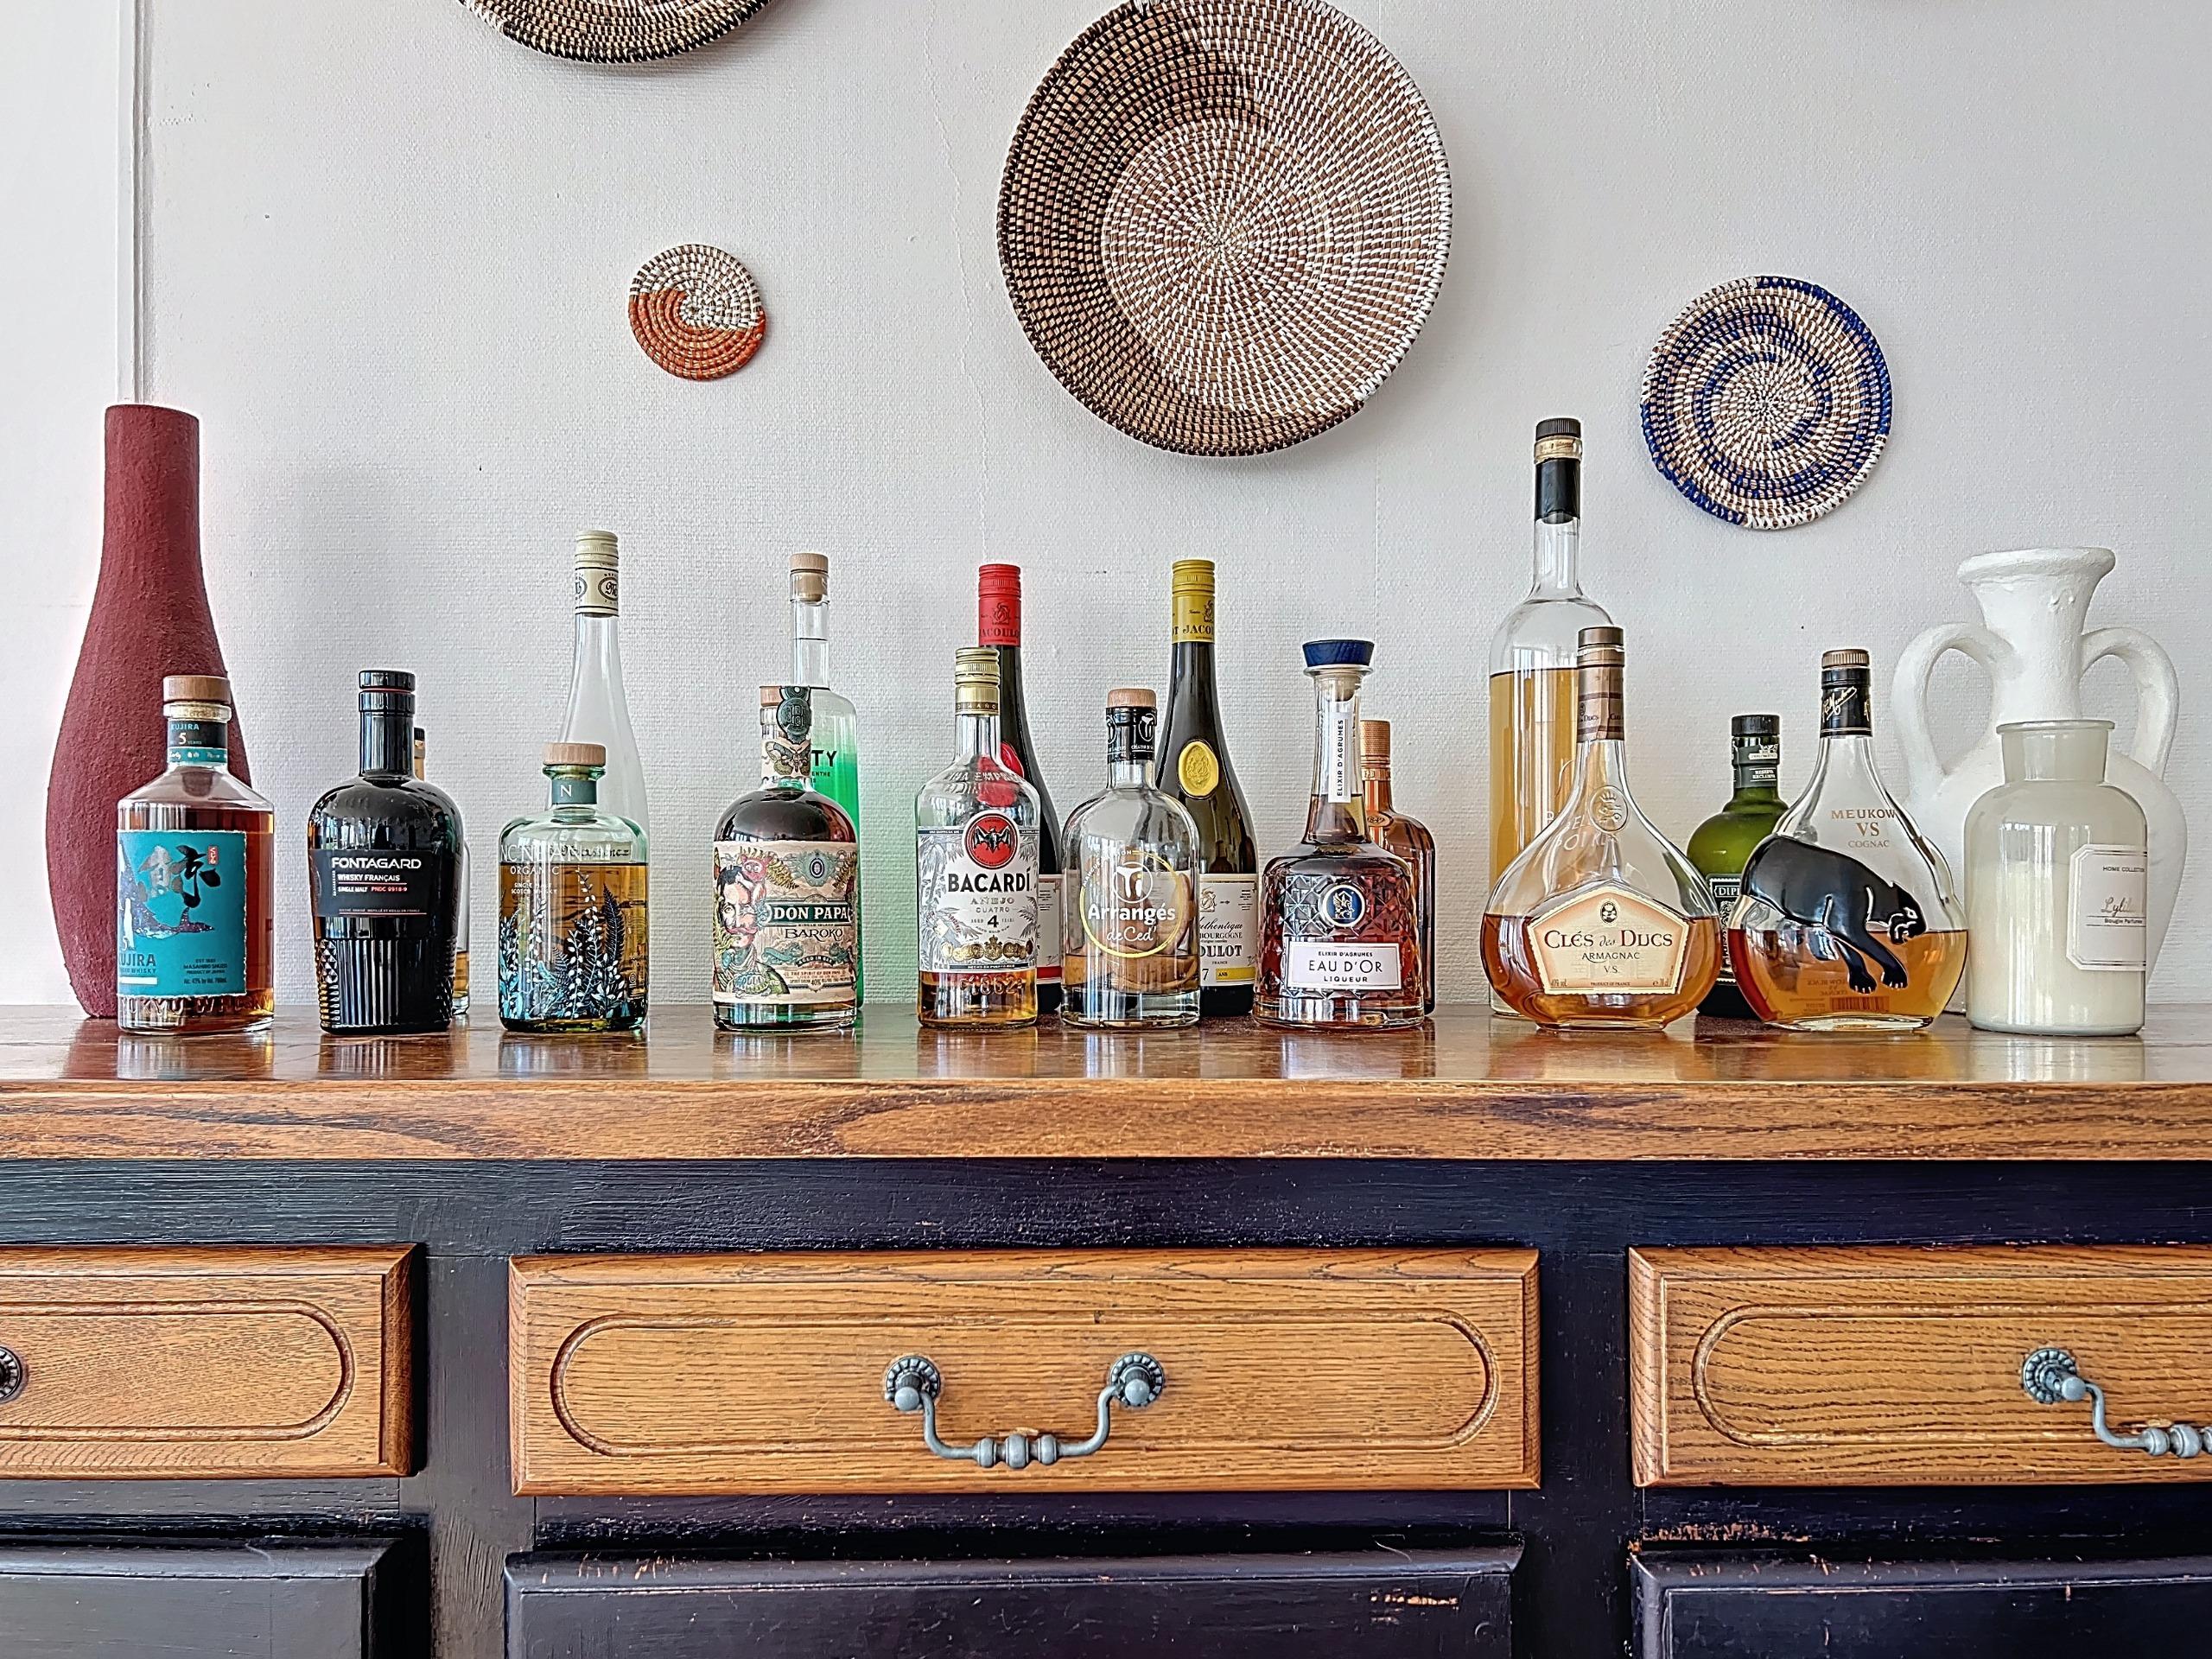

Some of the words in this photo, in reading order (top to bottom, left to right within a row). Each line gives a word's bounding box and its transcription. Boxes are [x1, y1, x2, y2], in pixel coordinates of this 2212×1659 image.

[179, 732, 187, 745] 5
[560, 785, 572, 797] N
[1831, 809, 1896, 819] MEUKOW
[1856, 822, 1880, 836] VS
[331, 856, 422, 869] FONTAGARD
[510, 866, 560, 875] ORGANC
[364, 874, 401, 882] FRANÇAIS
[948, 867, 1031, 893] BACARDÍ
[1116, 866, 1143, 898] Ti
[970, 896, 1015, 905] AÑEJO
[773, 906, 810, 920] DON
[814, 906, 848, 919] PAPA
[1088, 903, 1176, 925] Arrangés
[988, 915, 1000, 928] 4
[1200, 917, 1243, 932] uthentique
[785, 928, 843, 943] BAROKO
[1107, 927, 1123, 941] de
[1599, 935, 1616, 947] des
[119, 953, 156, 966] UJIRA
[1581, 951, 1640, 963] ARMAGNAC
[1308, 960, 1337, 972] EAU
[1344, 959, 1382, 974] D'OR
[1202, 968, 1209, 981] 7
